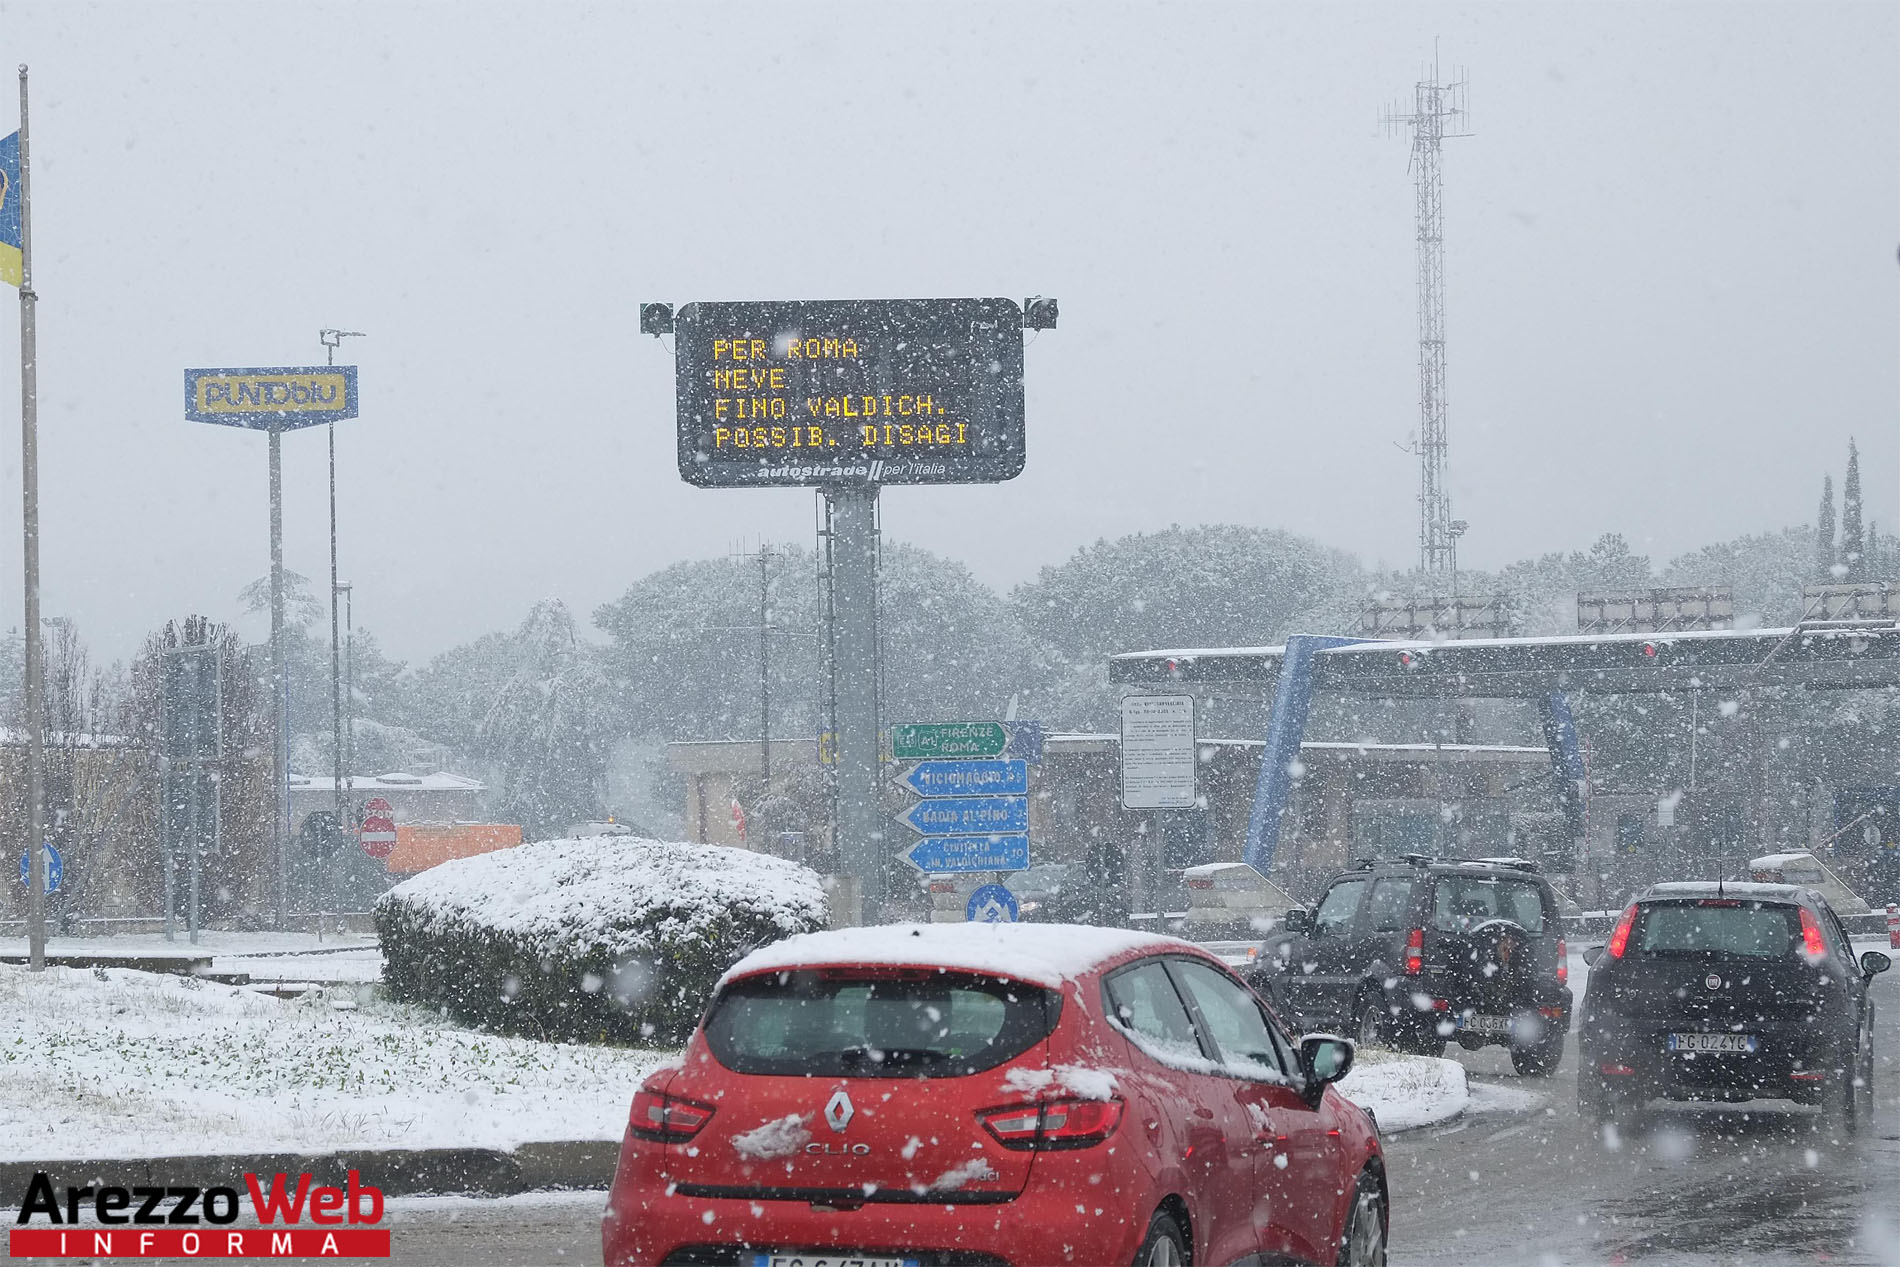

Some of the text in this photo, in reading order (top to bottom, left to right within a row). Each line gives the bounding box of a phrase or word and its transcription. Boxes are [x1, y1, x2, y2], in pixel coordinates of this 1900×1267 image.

[714, 338, 858, 360] PER ROMA
[714, 368, 785, 389] NEVE
[715, 395, 945, 419] FINO VALDICH.
[716, 423, 967, 448] POSSIB. DISAGI
[757, 463, 868, 478] autostrade
[883, 463, 907, 477] per
[941, 727, 994, 738] FIRENZE
[941, 742, 980, 752] ROMA
[805, 1142, 871, 1155] CLIO
